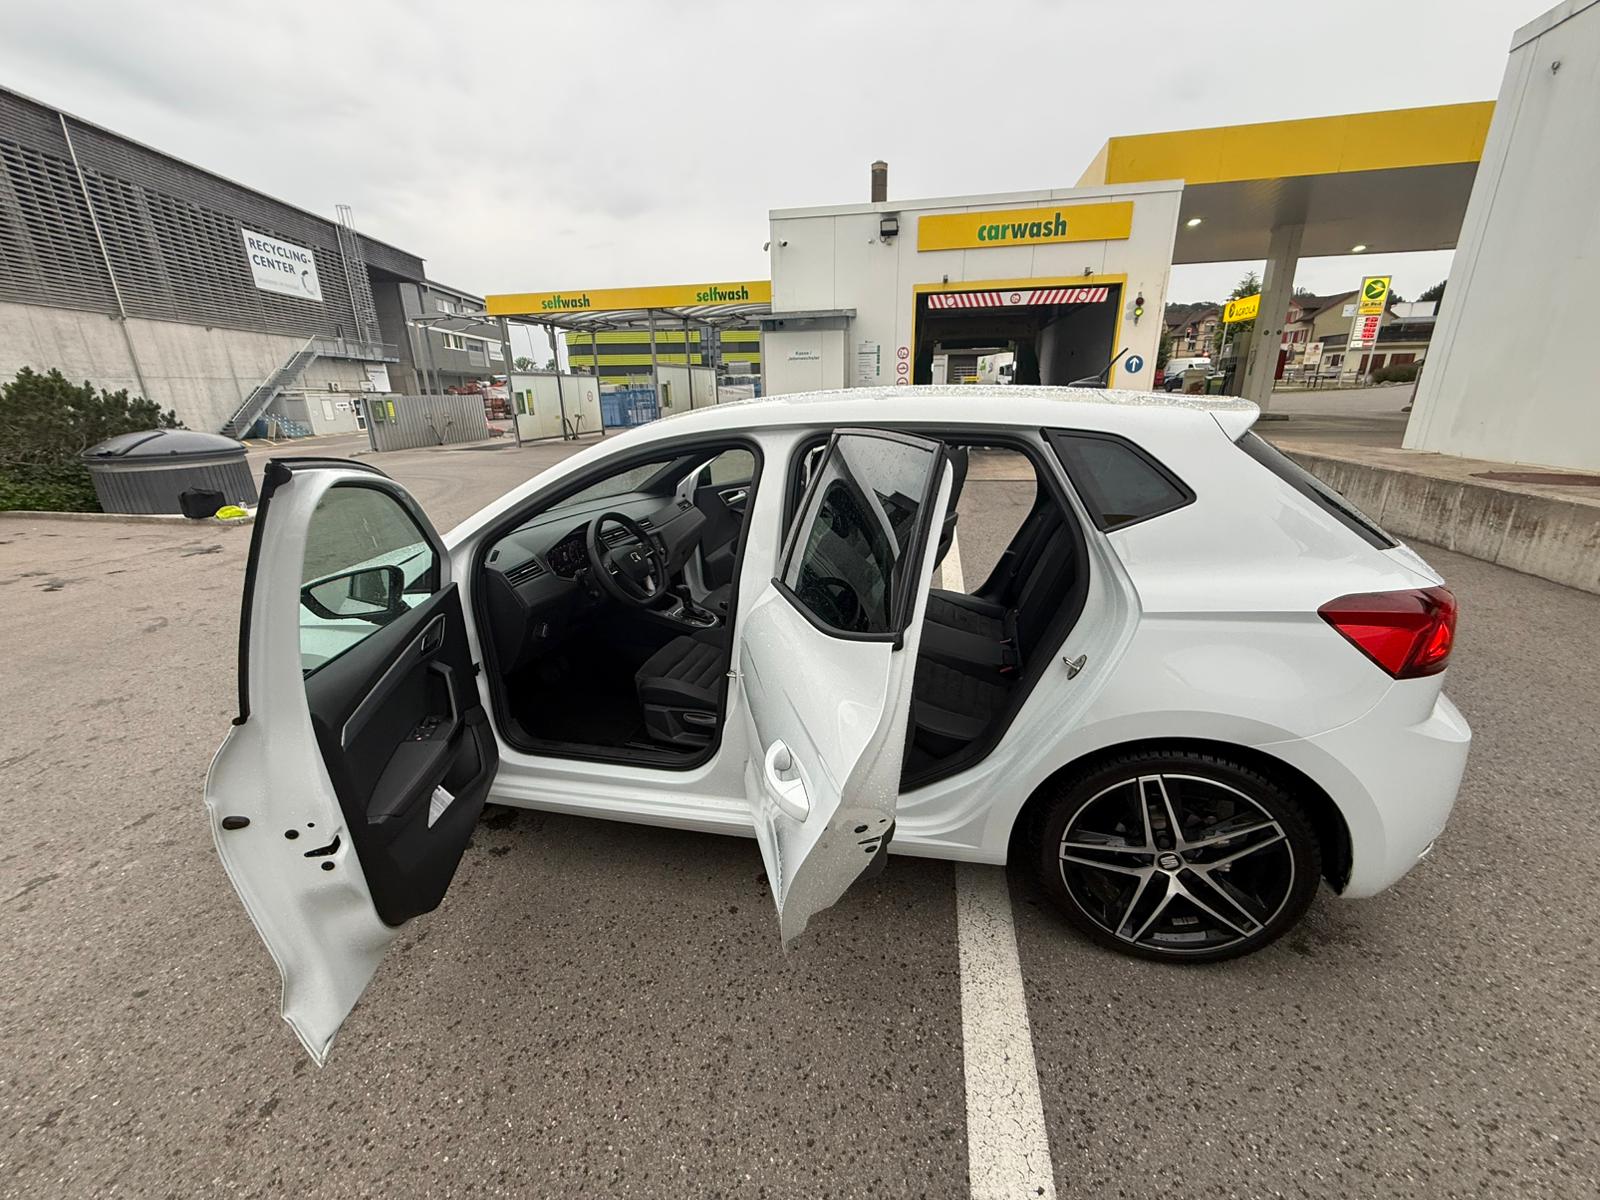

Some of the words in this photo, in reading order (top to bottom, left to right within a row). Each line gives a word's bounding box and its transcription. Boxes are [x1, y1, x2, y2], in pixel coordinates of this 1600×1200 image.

[977, 212, 1067, 241] carwash
[247, 237, 311, 264] RECYCLING-
[252, 254, 296, 275] CENTER
[541, 293, 591, 310] selfwash
[696, 285, 749, 302] selfwash
